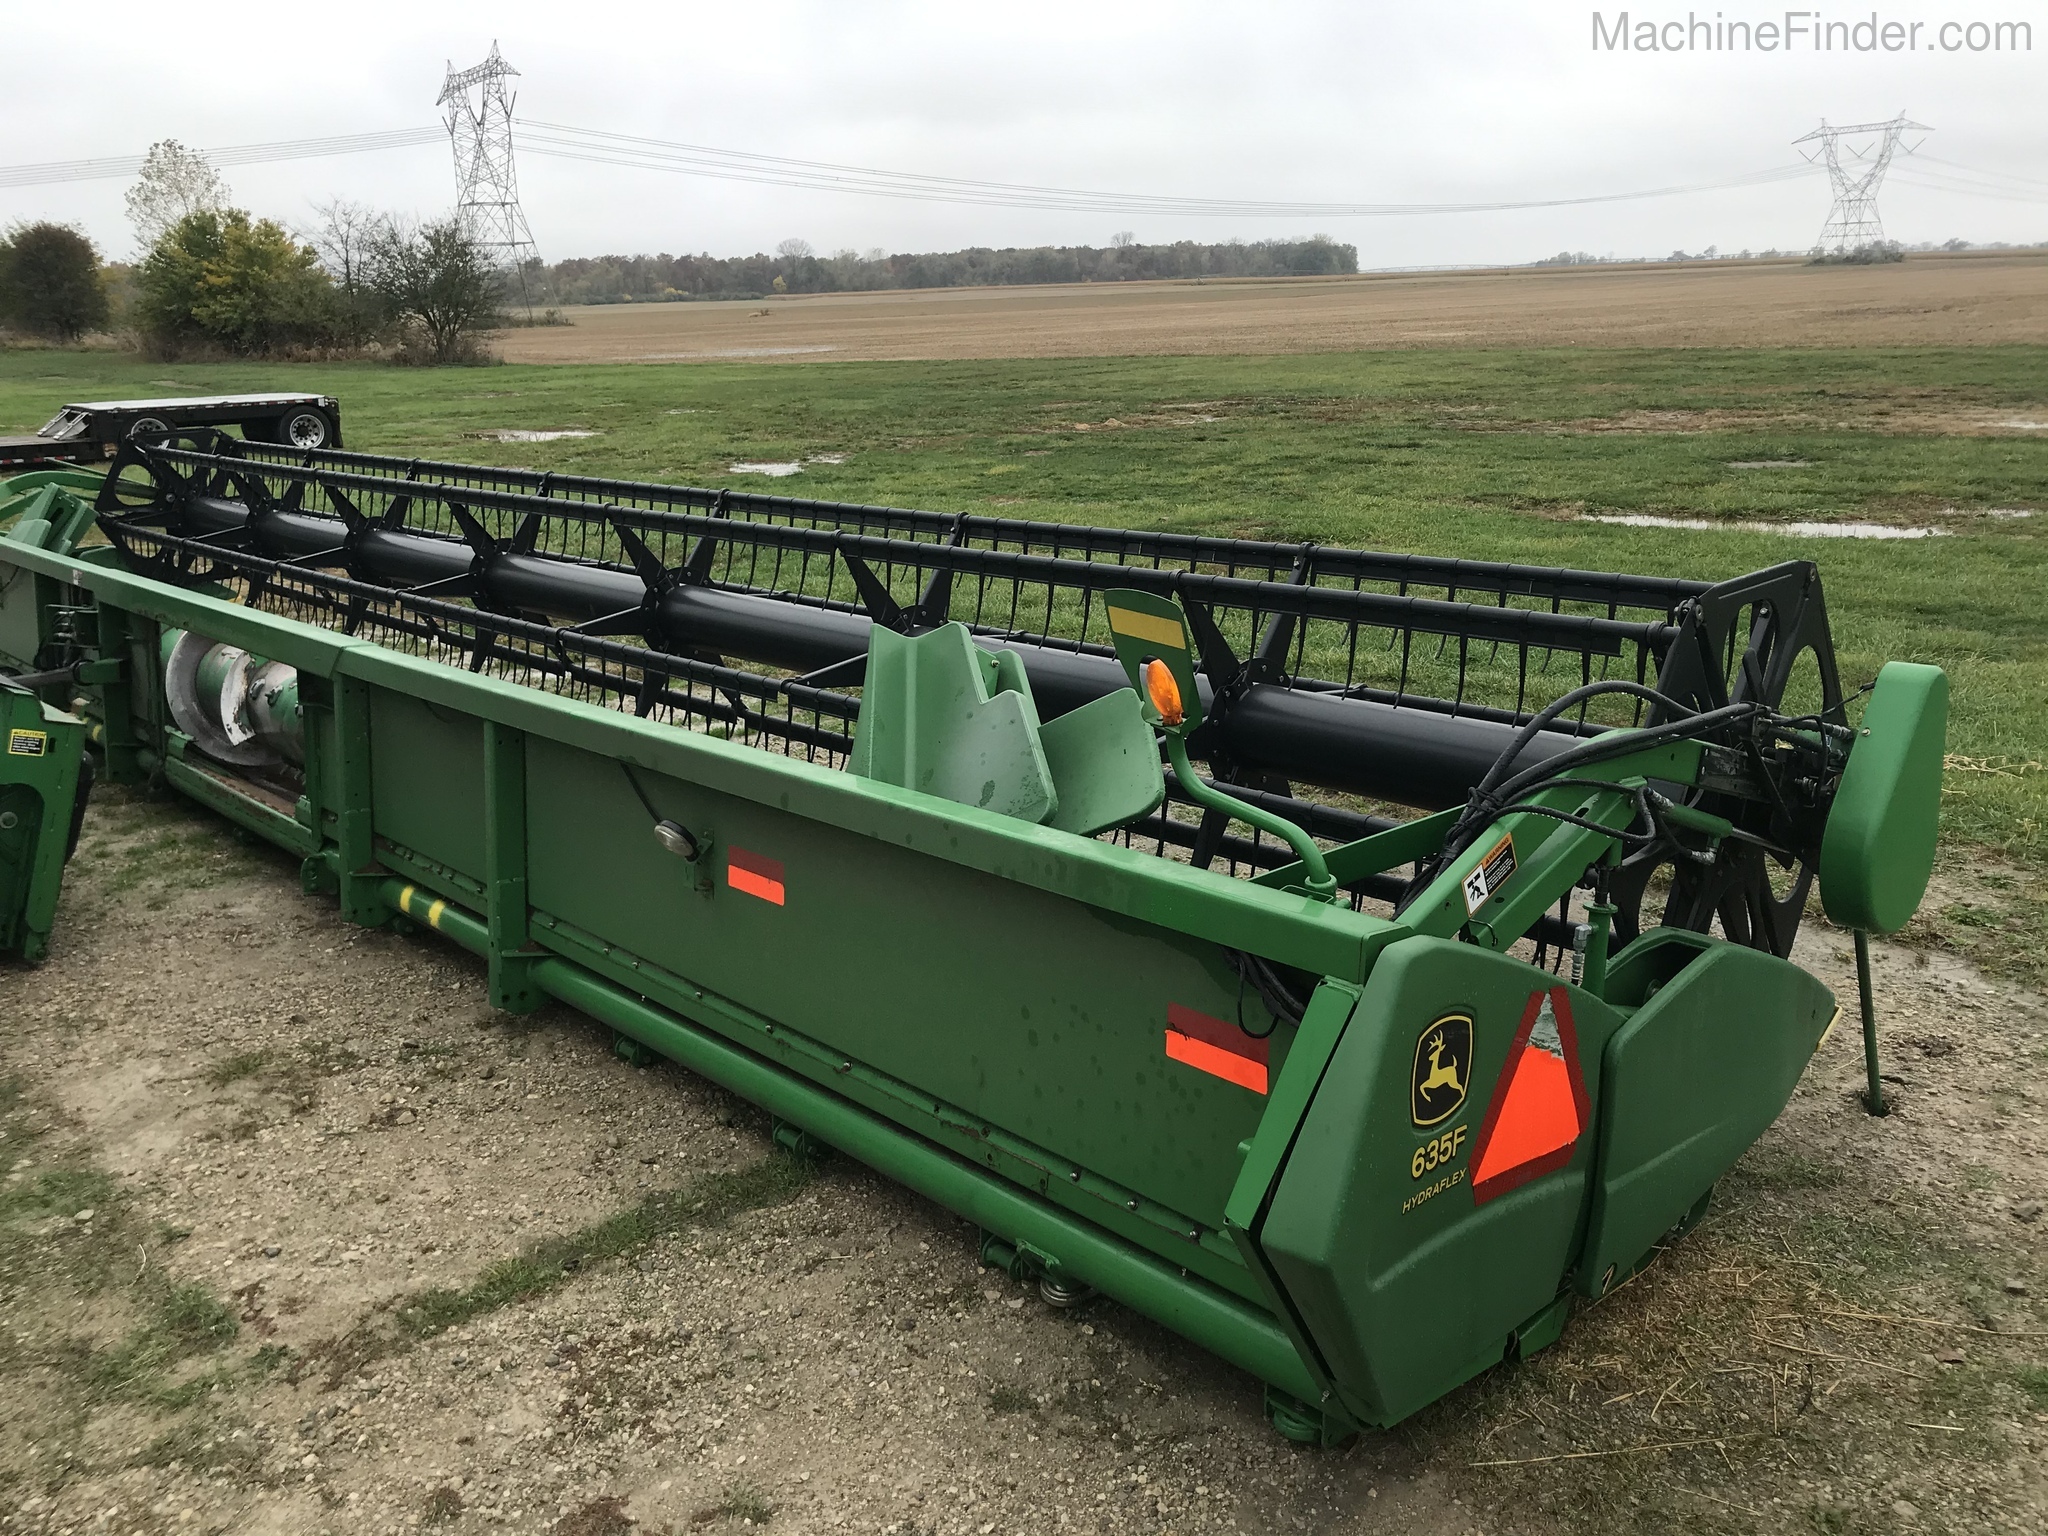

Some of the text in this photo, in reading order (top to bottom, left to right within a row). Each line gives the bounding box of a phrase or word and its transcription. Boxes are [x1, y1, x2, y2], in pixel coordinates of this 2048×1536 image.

[1488, 837, 1509, 863] WARNING
[1411, 1125, 1467, 1178] 635F
[1402, 1168, 1467, 1214] HYDRAFLEX
